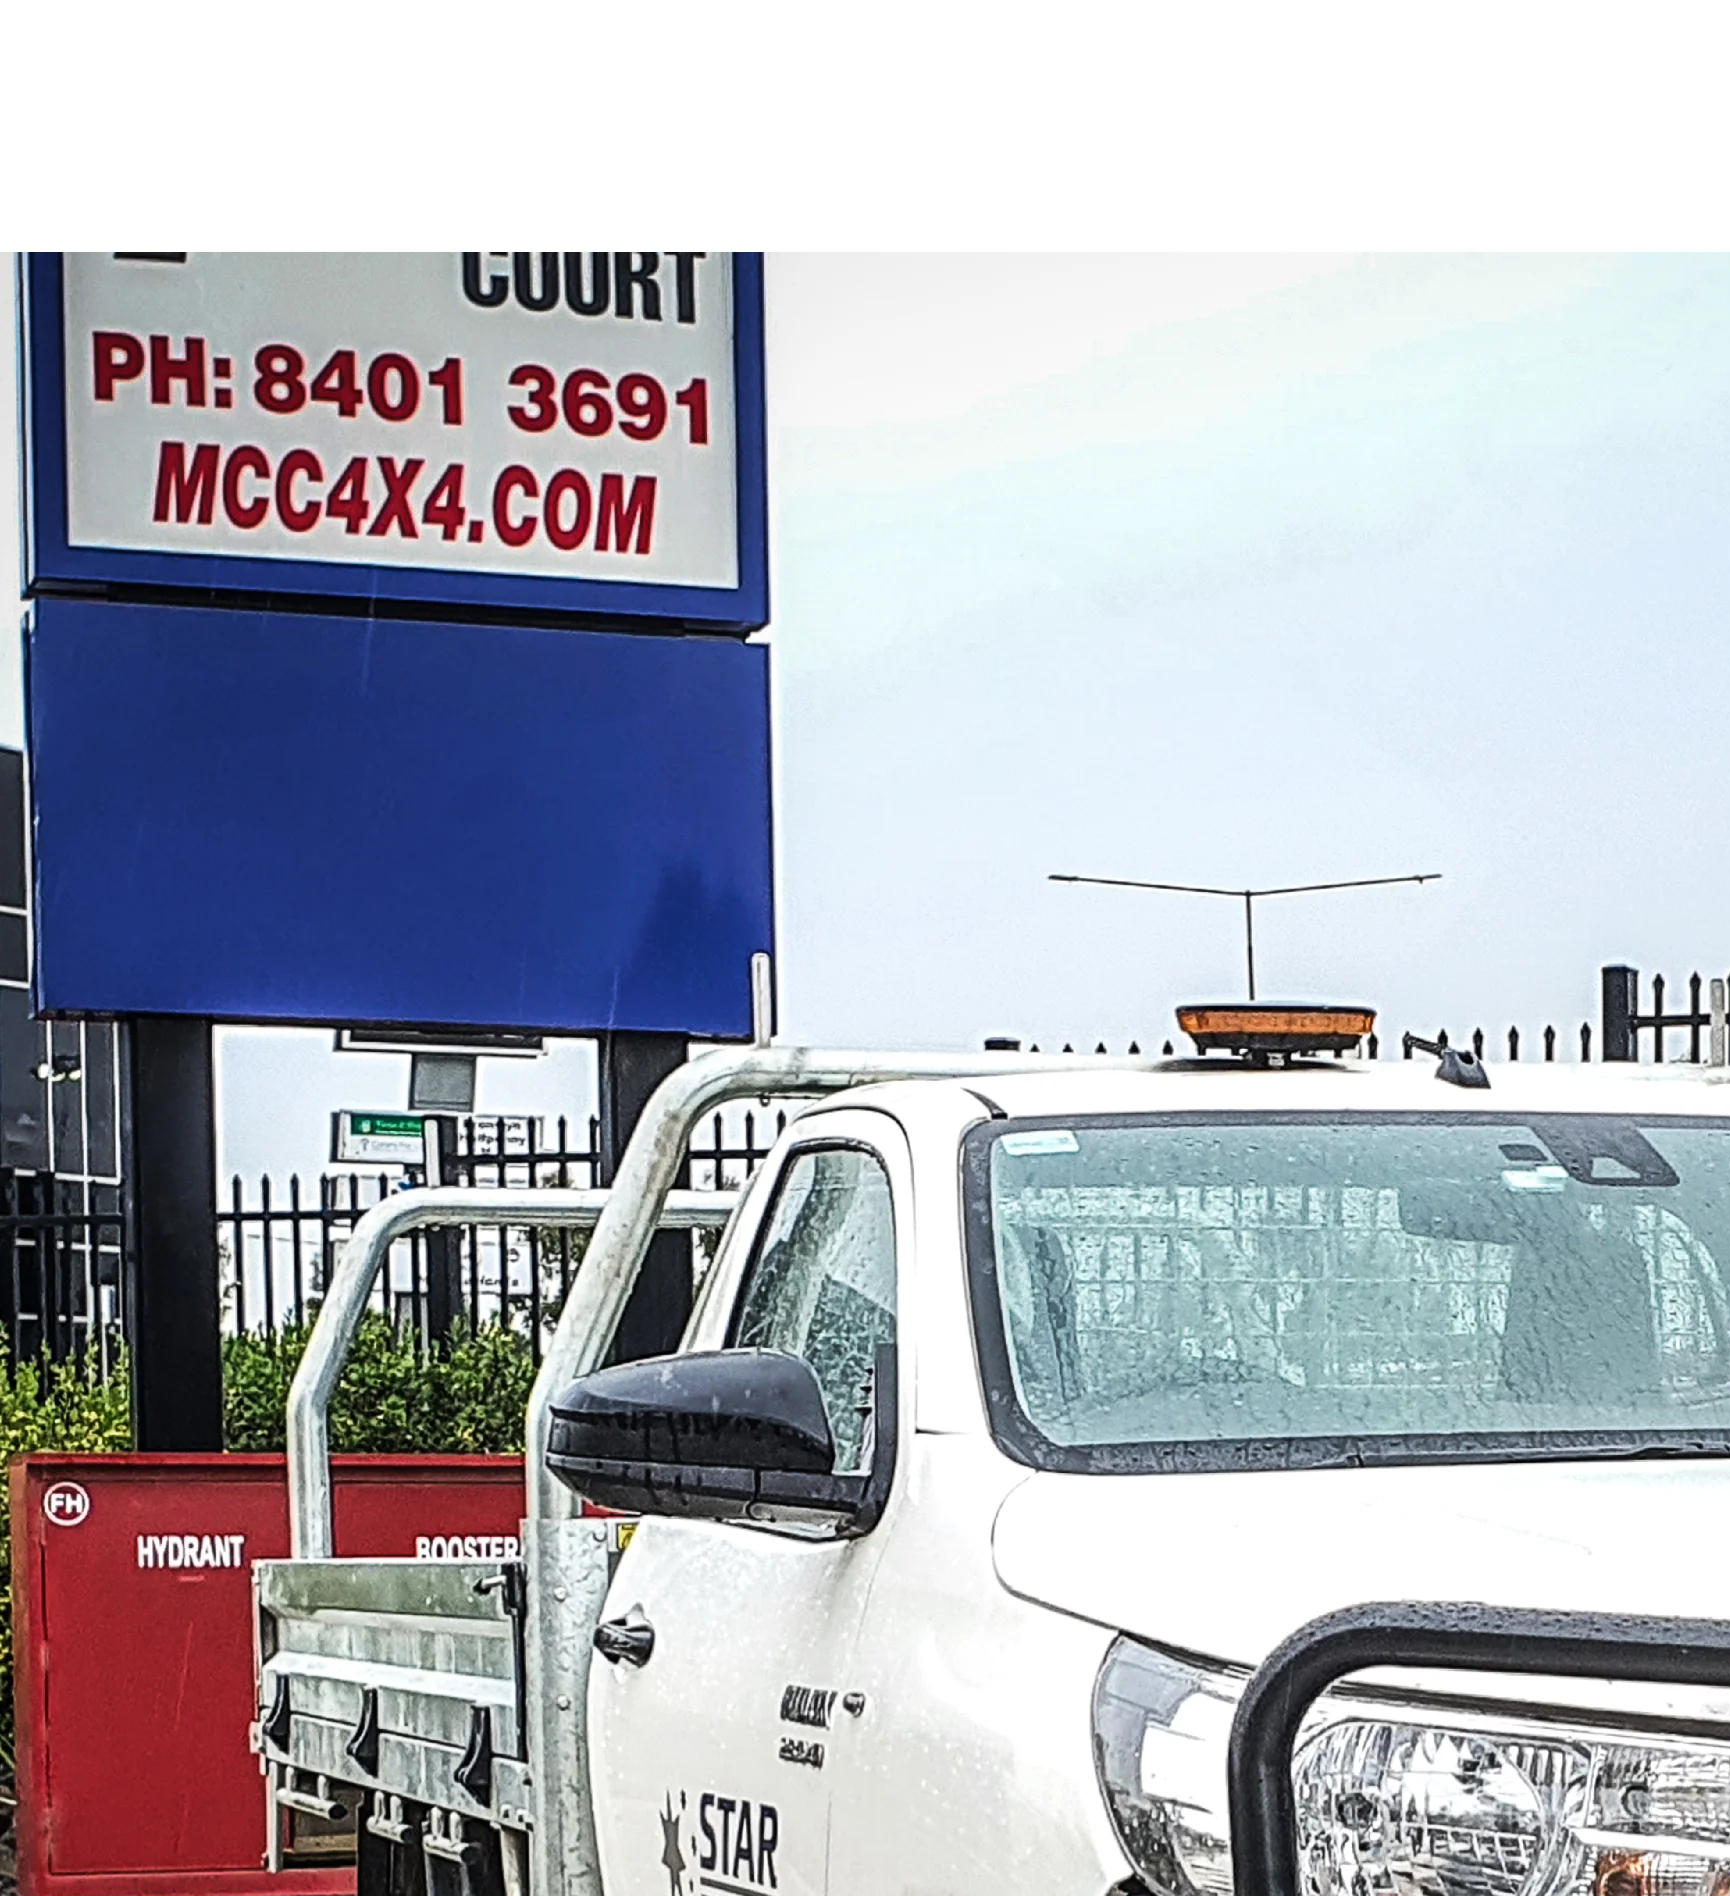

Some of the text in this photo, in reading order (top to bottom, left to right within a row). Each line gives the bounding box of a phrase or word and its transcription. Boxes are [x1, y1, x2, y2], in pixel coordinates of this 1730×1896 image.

[461, 252, 706, 324] COURT
[92, 331, 708, 445] PH: 8401 3691
[153, 441, 658, 555] MCC4X4.COM
[50, 1493, 84, 1513] FH
[137, 1534, 245, 1568] HYDRANT
[415, 1536, 519, 1560] BOOSTER
[700, 1793, 778, 1889] STAR
